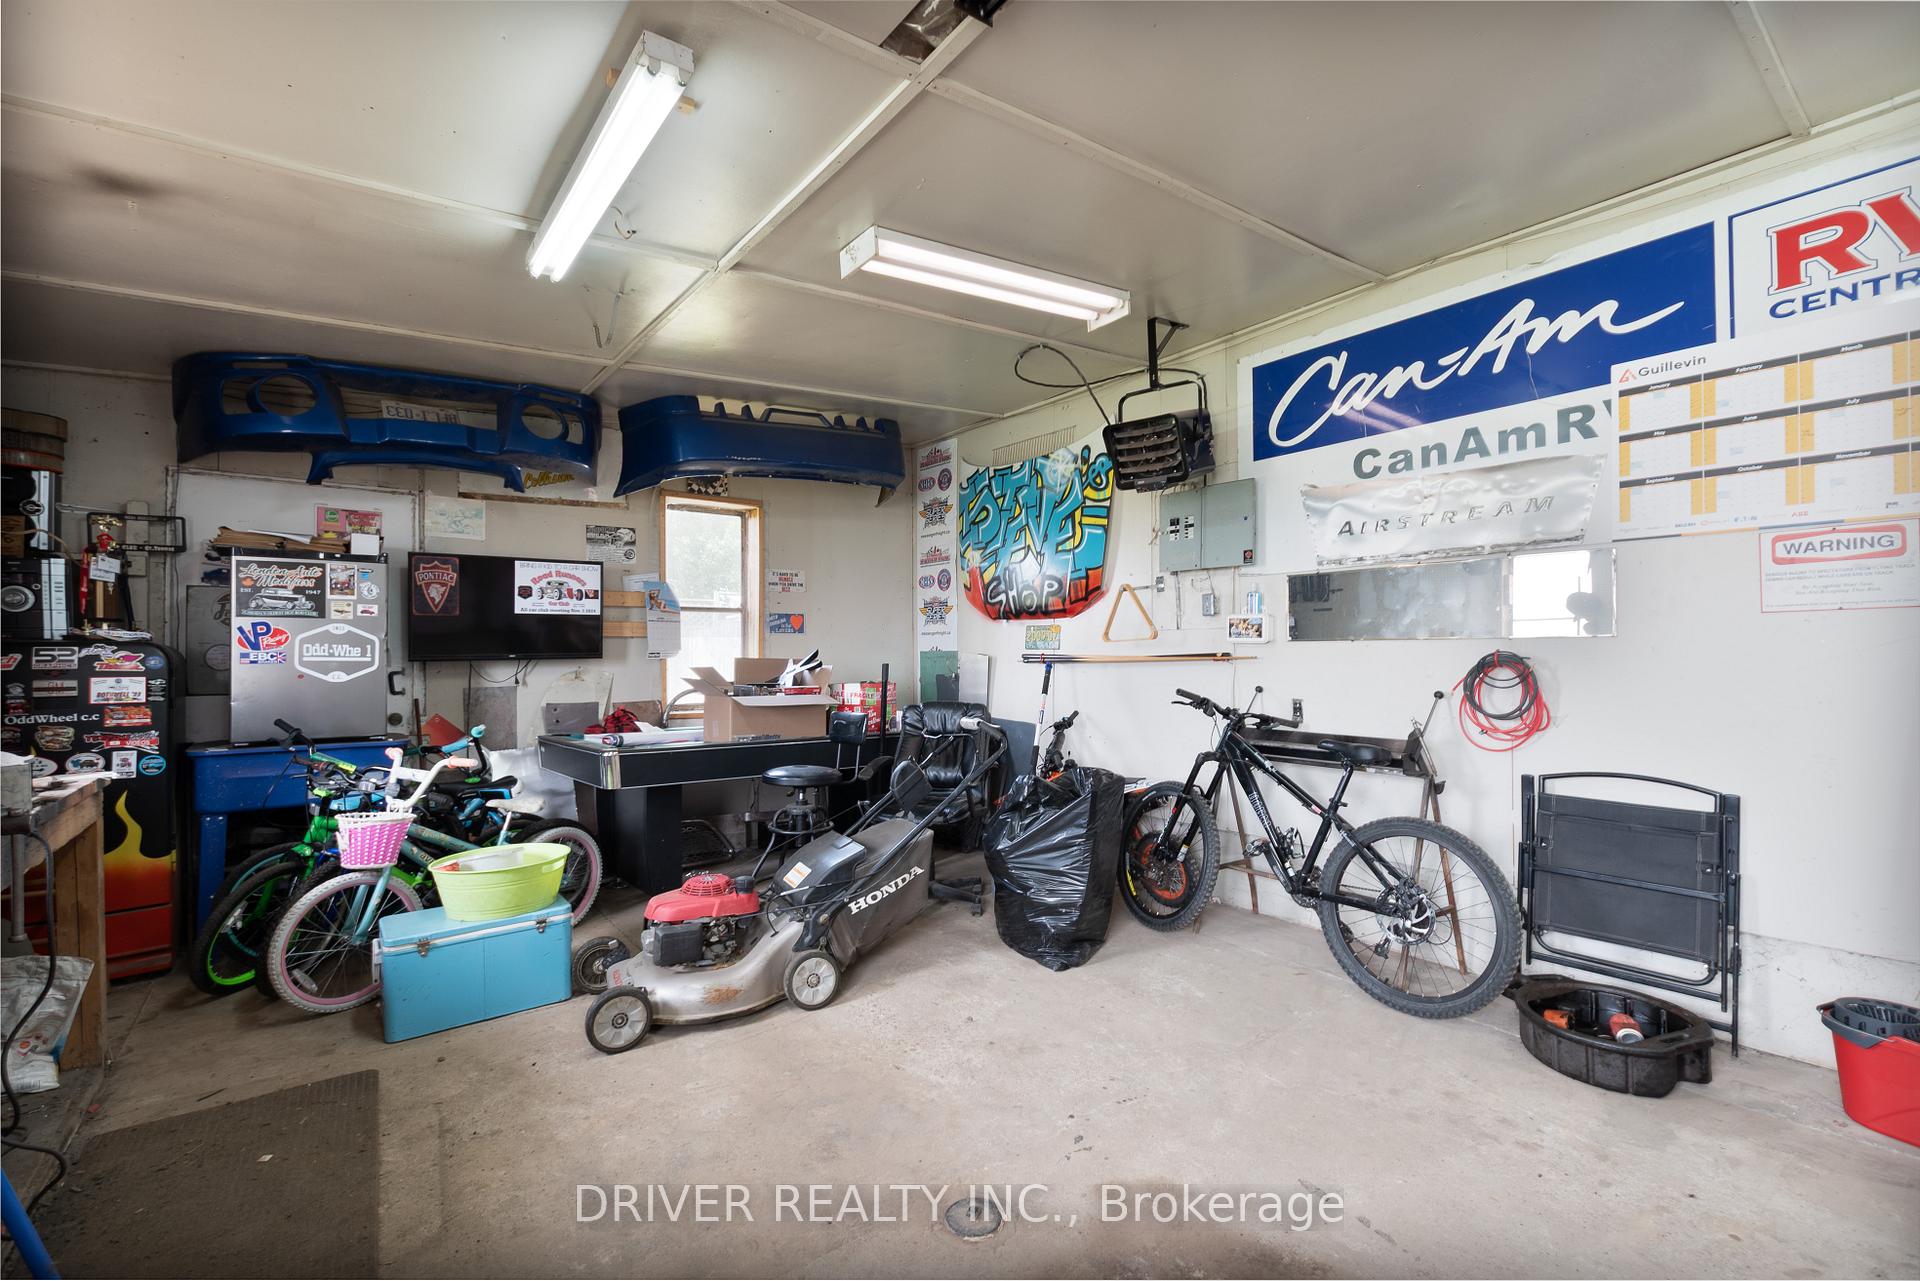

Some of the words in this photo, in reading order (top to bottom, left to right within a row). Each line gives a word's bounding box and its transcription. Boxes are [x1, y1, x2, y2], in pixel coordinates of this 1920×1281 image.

[1638, 355, 1706, 377] Guillevin
[1735, 363, 1764, 374] February
[1269, 298, 1683, 446] Can-Am
[1648, 382, 1671, 391] January
[1846, 398, 1861, 406] July
[1353, 400, 1612, 480] CanAmR
[1834, 450, 1872, 460] November
[1737, 465, 1763, 473] October
[1645, 476, 1675, 485] September
[1337, 495, 1555, 537] AIRSTREAM
[1783, 534, 1896, 555] WARNING
[419, 572, 453, 581] PONTIAC
[237, 622, 272, 651] VP
[250, 652, 277, 660] EBC
[5, 714, 78, 725] OddWheel
[848, 866, 924, 915] HONDA
